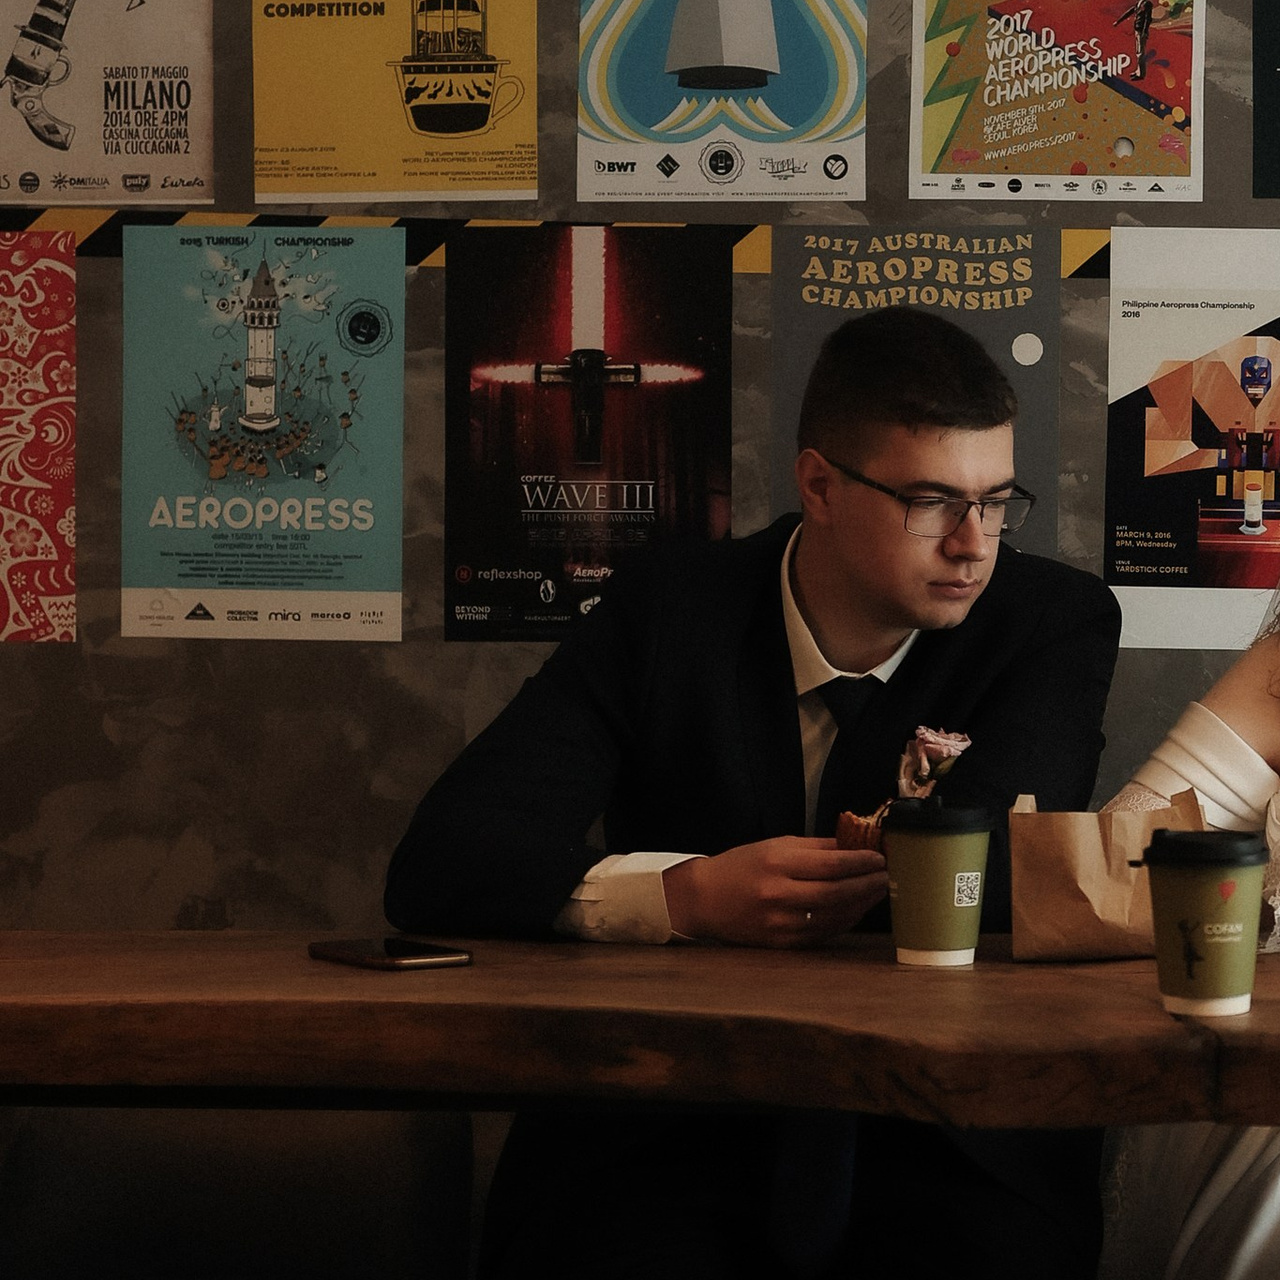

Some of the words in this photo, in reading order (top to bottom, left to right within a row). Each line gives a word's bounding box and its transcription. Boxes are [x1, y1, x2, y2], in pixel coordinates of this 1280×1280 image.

[263, 2, 385, 17] COMPETITION
[986, 9, 1033, 40] 2017
[985, 26, 1056, 60] WORLD
[984, 36, 1101, 85] AEROPRESS
[983, 53, 1130, 107] CHAMPIONSHIP
[104, 81, 190, 109] MILANO
[103, 111, 130, 127] 2014
[135, 111, 158, 126] ORE
[163, 111, 187, 126] 4PM
[607, 162, 636, 172] BWT
[180, 238, 202, 247] 2015
[205, 237, 249, 246] TURKISH
[275, 237, 354, 247] CHAMPIONSHIP
[804, 235, 859, 255] 2017
[867, 233, 1033, 254] AUSTRALIAN
[801, 256, 1033, 286] AEROPRESS
[801, 285, 1033, 310] CHAMPIONSHIP
[1122, 301, 1158, 309] Philippine
[1160, 301, 1198, 309] Aeropress
[1200, 302, 1254, 310] Championship
[522, 484, 608, 509] WAVE
[622, 484, 654, 508] III
[149, 496, 375, 530] AEROPRESS
[478, 569, 542, 582] reflexshop
